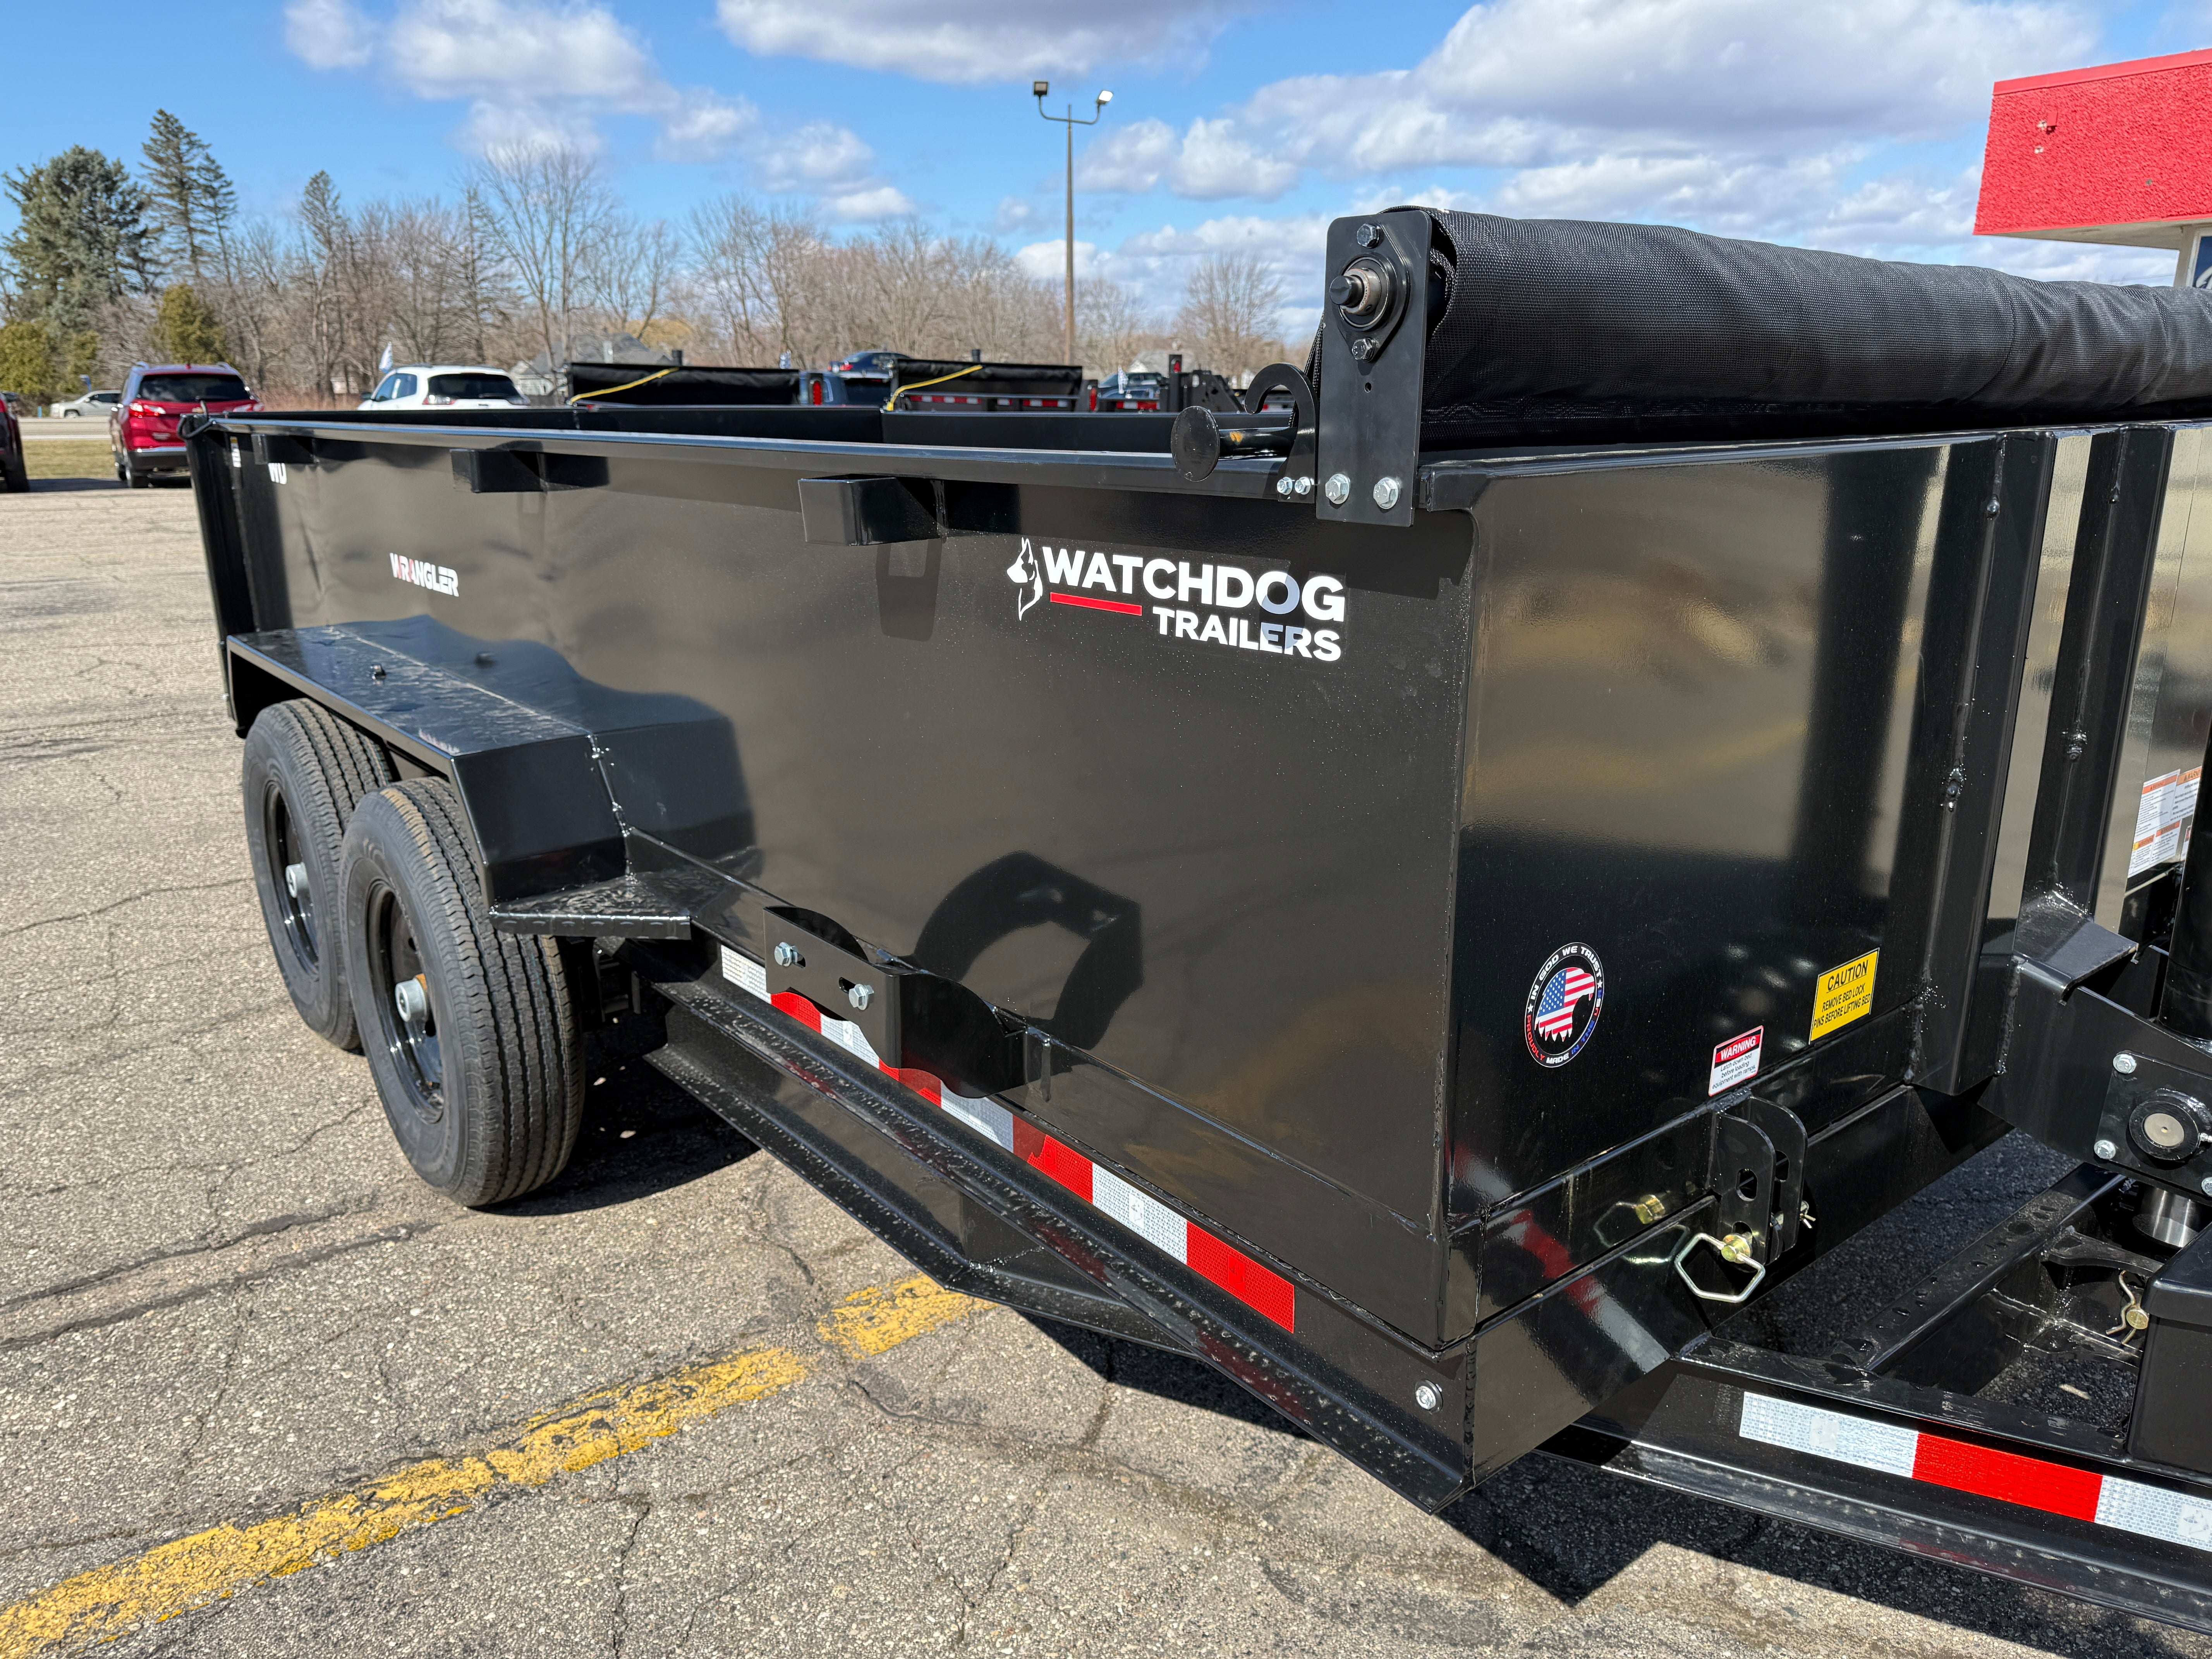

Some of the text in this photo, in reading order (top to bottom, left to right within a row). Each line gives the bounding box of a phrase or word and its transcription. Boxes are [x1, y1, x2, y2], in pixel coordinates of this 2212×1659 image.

[390, 553, 459, 597] WRANGLER
[1042, 546, 1345, 623] WATCHDOG
[1153, 606, 1341, 661] TRAILERS
[1530, 946, 1602, 1000] IN GOD WE TRUST
[1828, 959, 1869, 991] CAUTION
[1813, 993, 1871, 1029] PINS BEFORE LIFTING BED
[1822, 983, 1865, 1012] REMOVE BED LOCK
[1527, 1014, 1546, 1060] PROUDLY
[1546, 1053, 1569, 1064] MADE
[1721, 1036, 1756, 1061] WARNING
